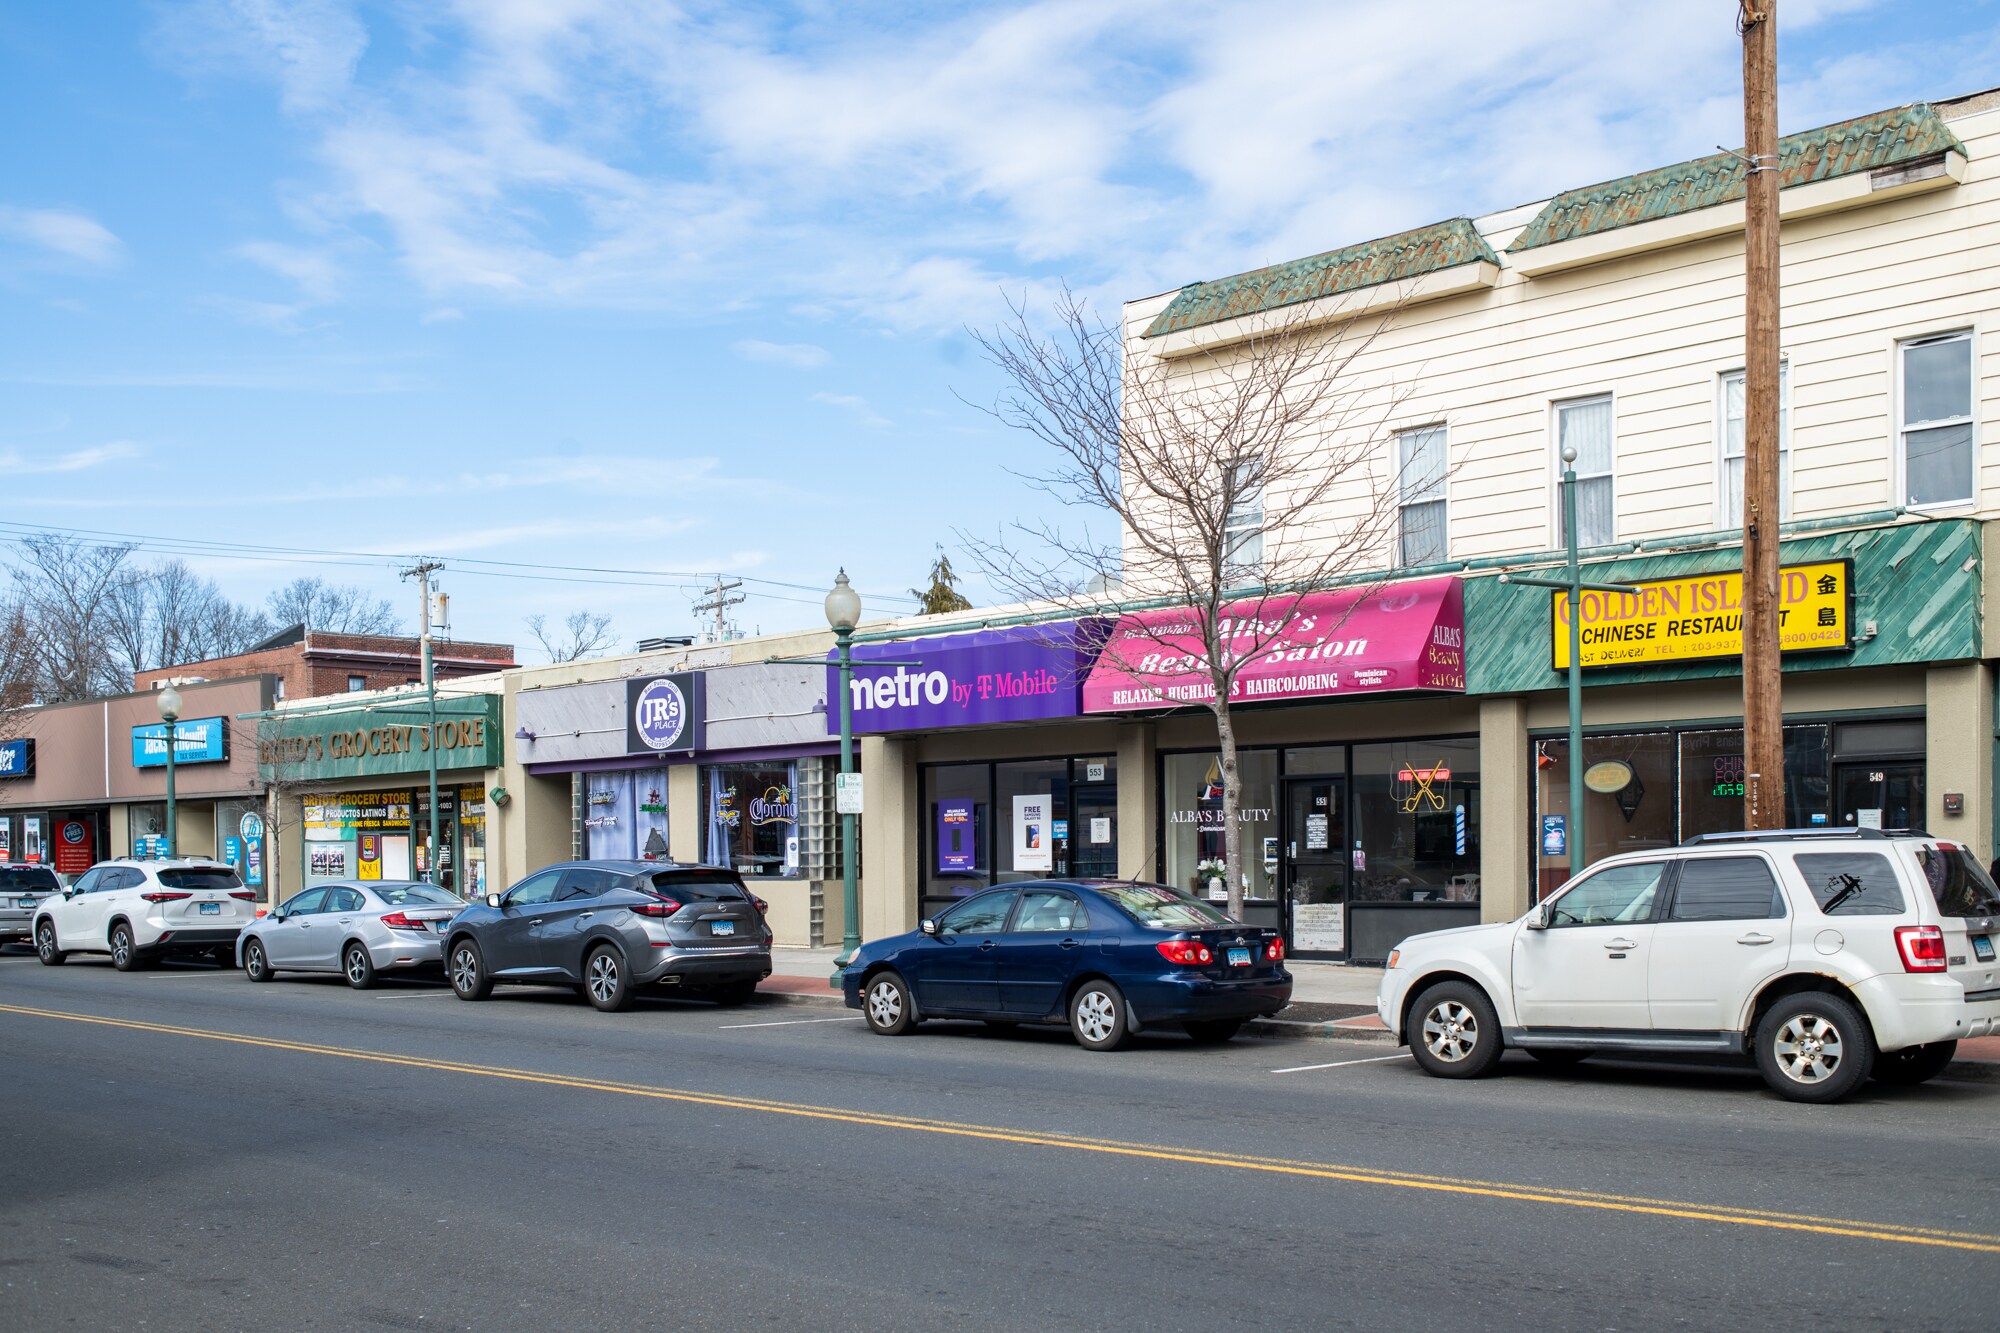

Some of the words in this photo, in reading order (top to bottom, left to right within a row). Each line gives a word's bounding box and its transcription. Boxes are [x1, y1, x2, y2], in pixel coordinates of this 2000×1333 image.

[1690, 572, 1809, 614] ISLD
[1581, 622, 1657, 645] CHINESE
[1666, 609, 1790, 638] RESTAUT
[1433, 624, 1461, 648] ALBA'S
[1264, 637, 1368, 664] Salon
[1600, 647, 1646, 661] DELIVERY
[1654, 644, 1675, 655] TEL
[1354, 669, 1388, 679] Dominican
[951, 679, 973, 709] by
[995, 668, 1057, 698] Mobile
[1112, 687, 1163, 705] RELAXER
[1168, 680, 1240, 700] HIGHLIGS
[1246, 673, 1339, 696] HAIRCOLORING
[1359, 677, 1383, 687] stylists
[643, 693, 679, 729] JR's
[654, 719, 678, 731] PLACE
[144, 729, 178, 755] Jacksn
[329, 726, 413, 760] GROCERY
[419, 718, 485, 752] STORE
[188, 751, 208, 760] SERVICE
[1713, 756, 1746, 771] CHIN
[1089, 768, 1102, 777] 553
[1715, 769, 1746, 784] FOO
[1869, 772, 1884, 782] 549
[339, 793, 381, 806] GROCERY
[381, 792, 411, 805] STORE
[325, 808, 361, 818] PRODUCTOS
[361, 808, 387, 818] LATINOS
[749, 797, 798, 821] Corona
[1024, 805, 1041, 813] FREE
[1170, 809, 1213, 823] ALBA'S
